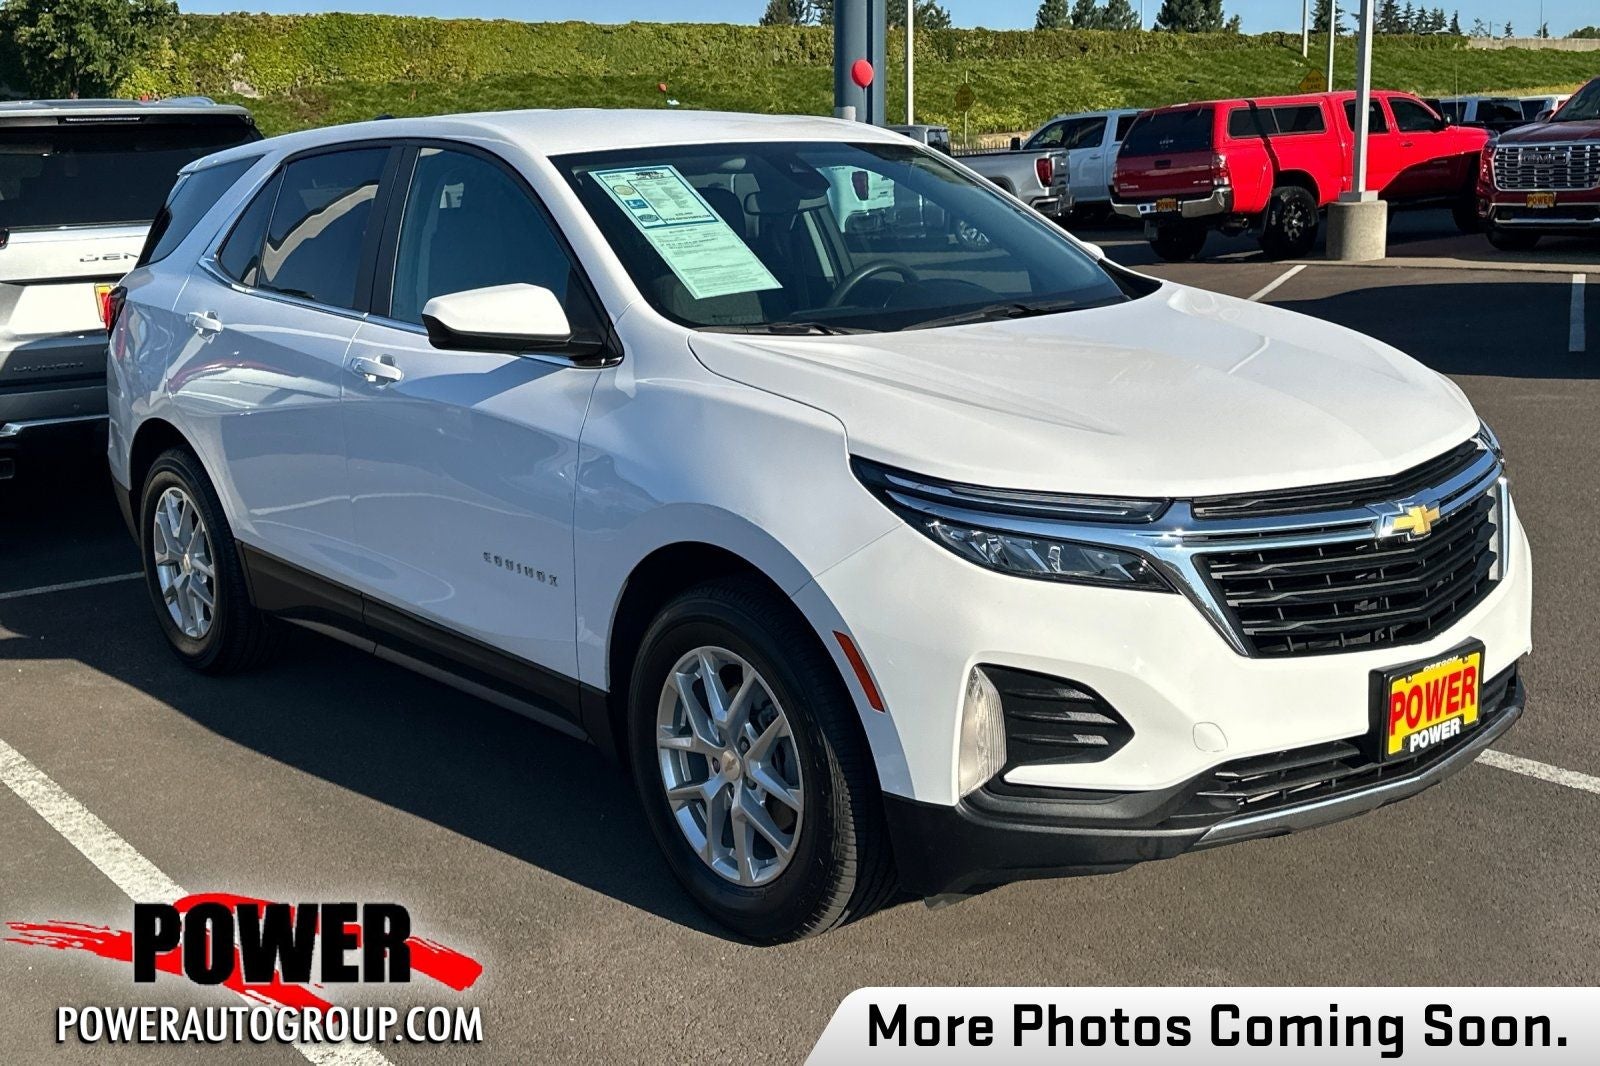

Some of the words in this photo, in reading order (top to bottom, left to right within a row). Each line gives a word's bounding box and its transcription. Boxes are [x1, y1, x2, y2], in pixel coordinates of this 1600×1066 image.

[1527, 193, 1554, 205] POWER
[483, 551, 559, 587] EQUINOX
[1389, 666, 1476, 737] POWER
[1409, 717, 1461, 753] POWER
